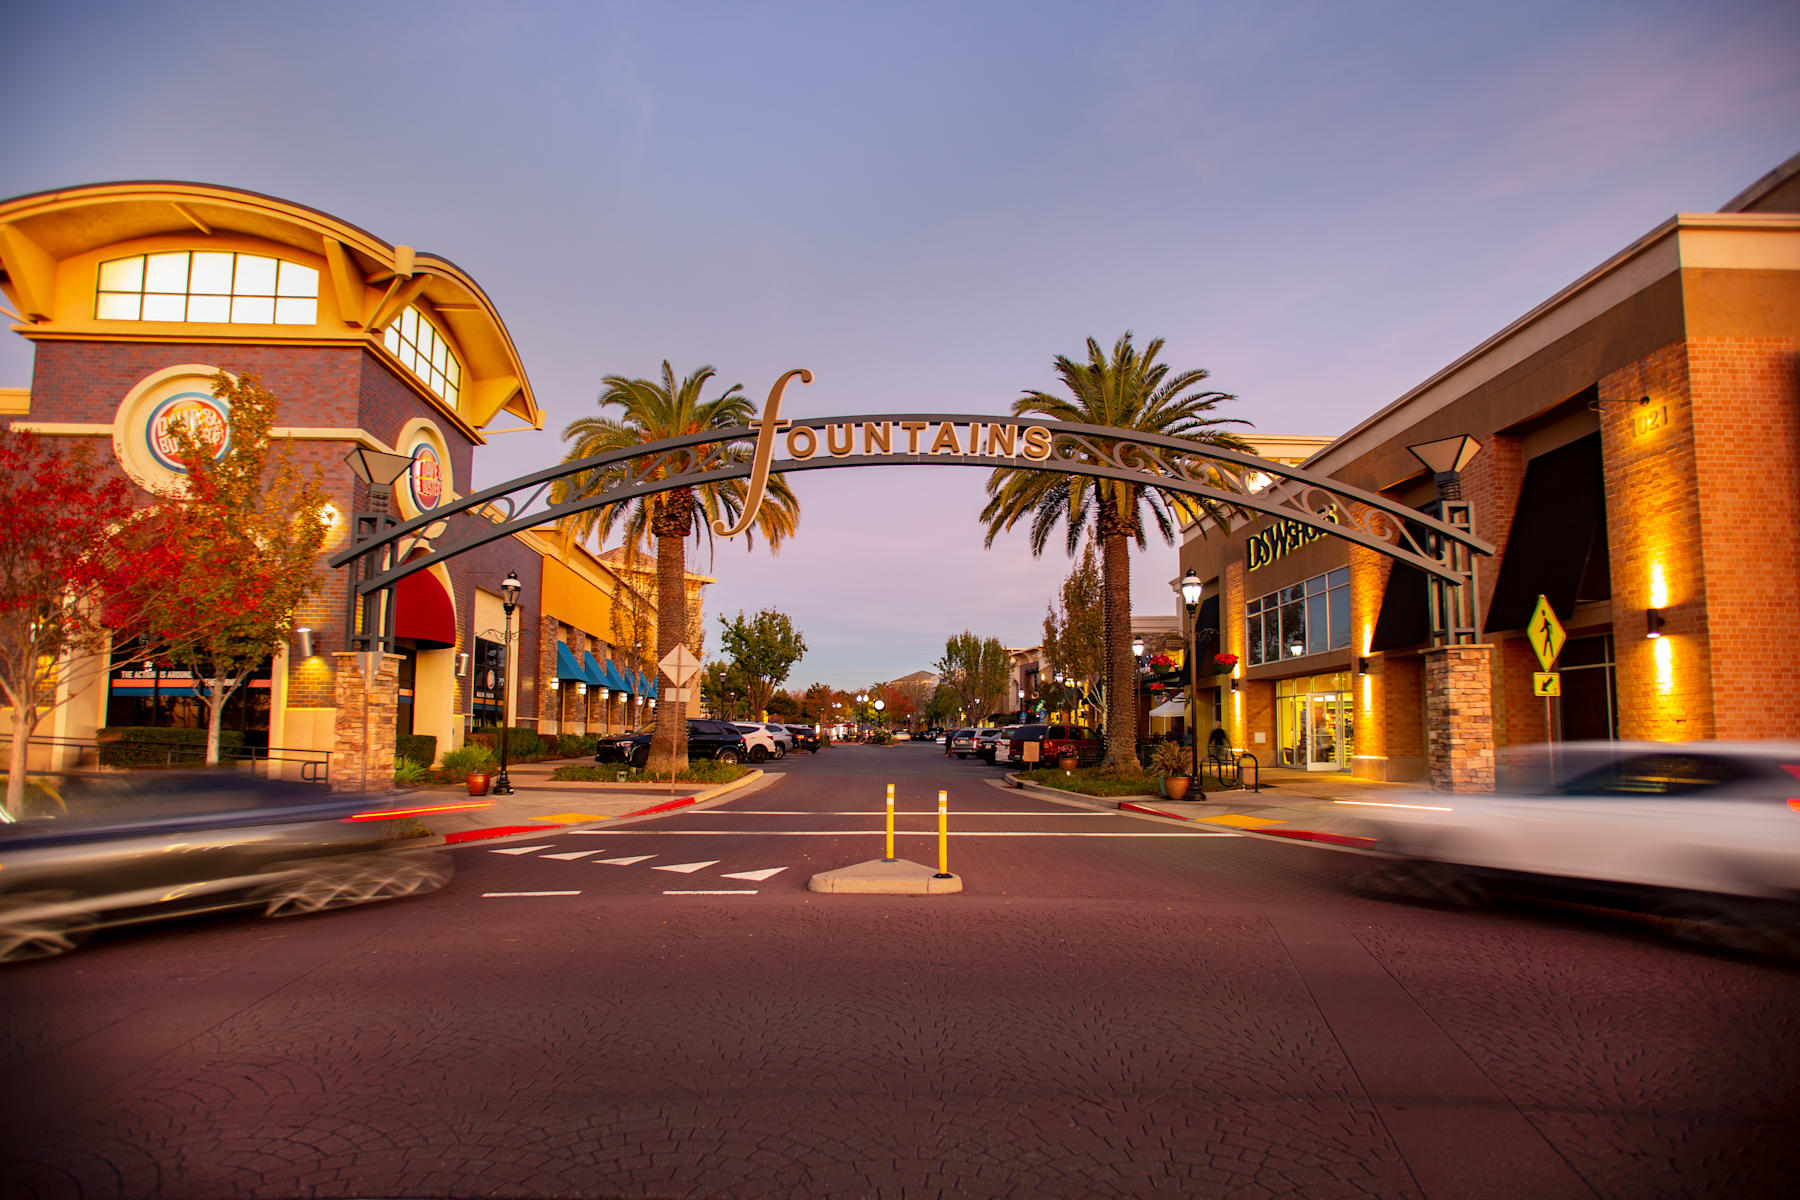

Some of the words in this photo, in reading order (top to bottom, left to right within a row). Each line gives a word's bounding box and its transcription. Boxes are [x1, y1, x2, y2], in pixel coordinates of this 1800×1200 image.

[1630, 405, 1668, 439] 1021
[120, 670, 133, 679] THE
[133, 670, 156, 679] ACTION
[159, 670, 167, 679] IS
